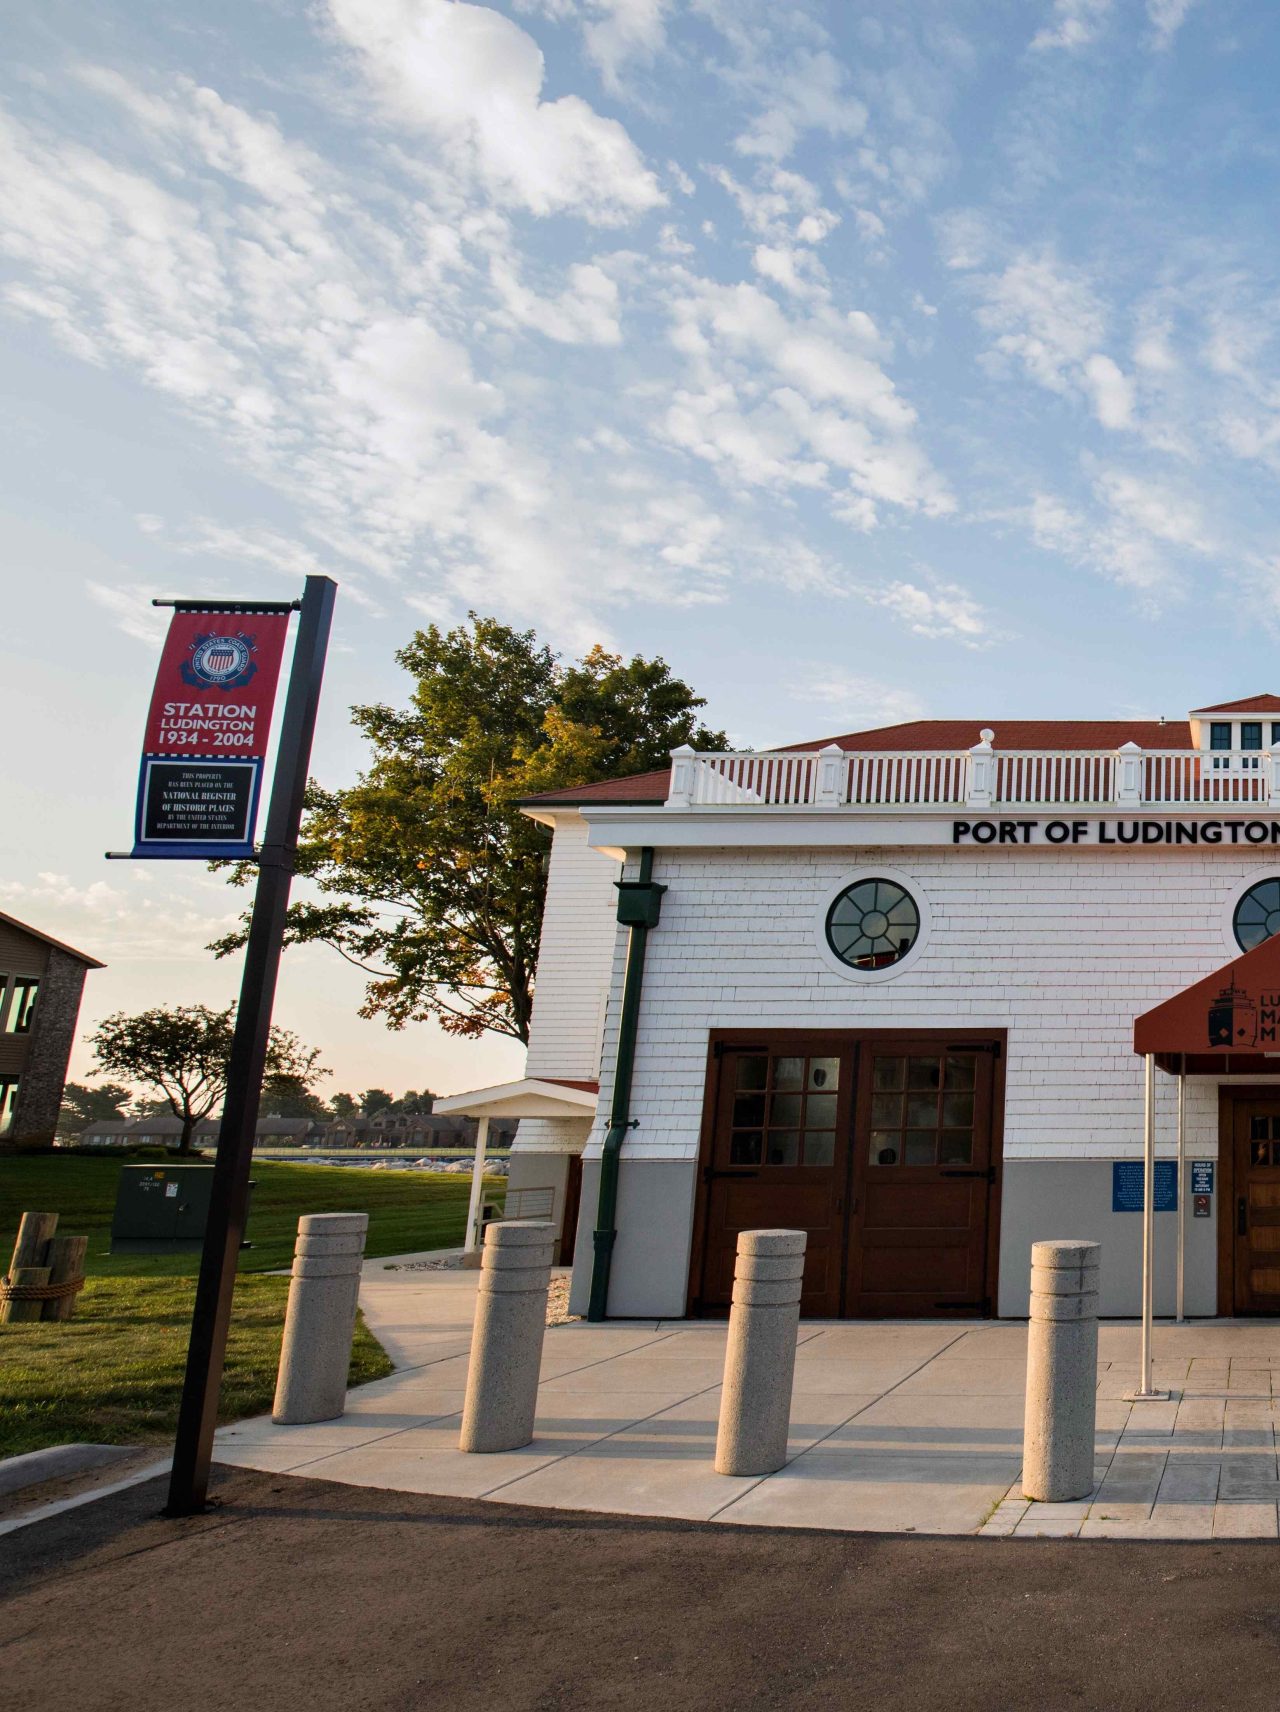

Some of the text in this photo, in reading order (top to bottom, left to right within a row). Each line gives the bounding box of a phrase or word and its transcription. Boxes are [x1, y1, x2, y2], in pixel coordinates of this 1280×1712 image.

[202, 638, 225, 650] STATES
[228, 639, 246, 652] COAST
[237, 652, 248, 672] GUARD
[163, 702, 257, 718] STATION
[160, 718, 254, 731] LUDINGTON
[159, 731, 198, 744] 1934
[212, 732, 254, 747] 2004
[163, 791, 237, 800] NATIONAL REGISTER
[162, 803, 235, 813] OF HISTORIC PLACES
[156, 822, 190, 830] DEPARTMENT
[953, 821, 1038, 843] PORT
[1045, 821, 1088, 843] OF
